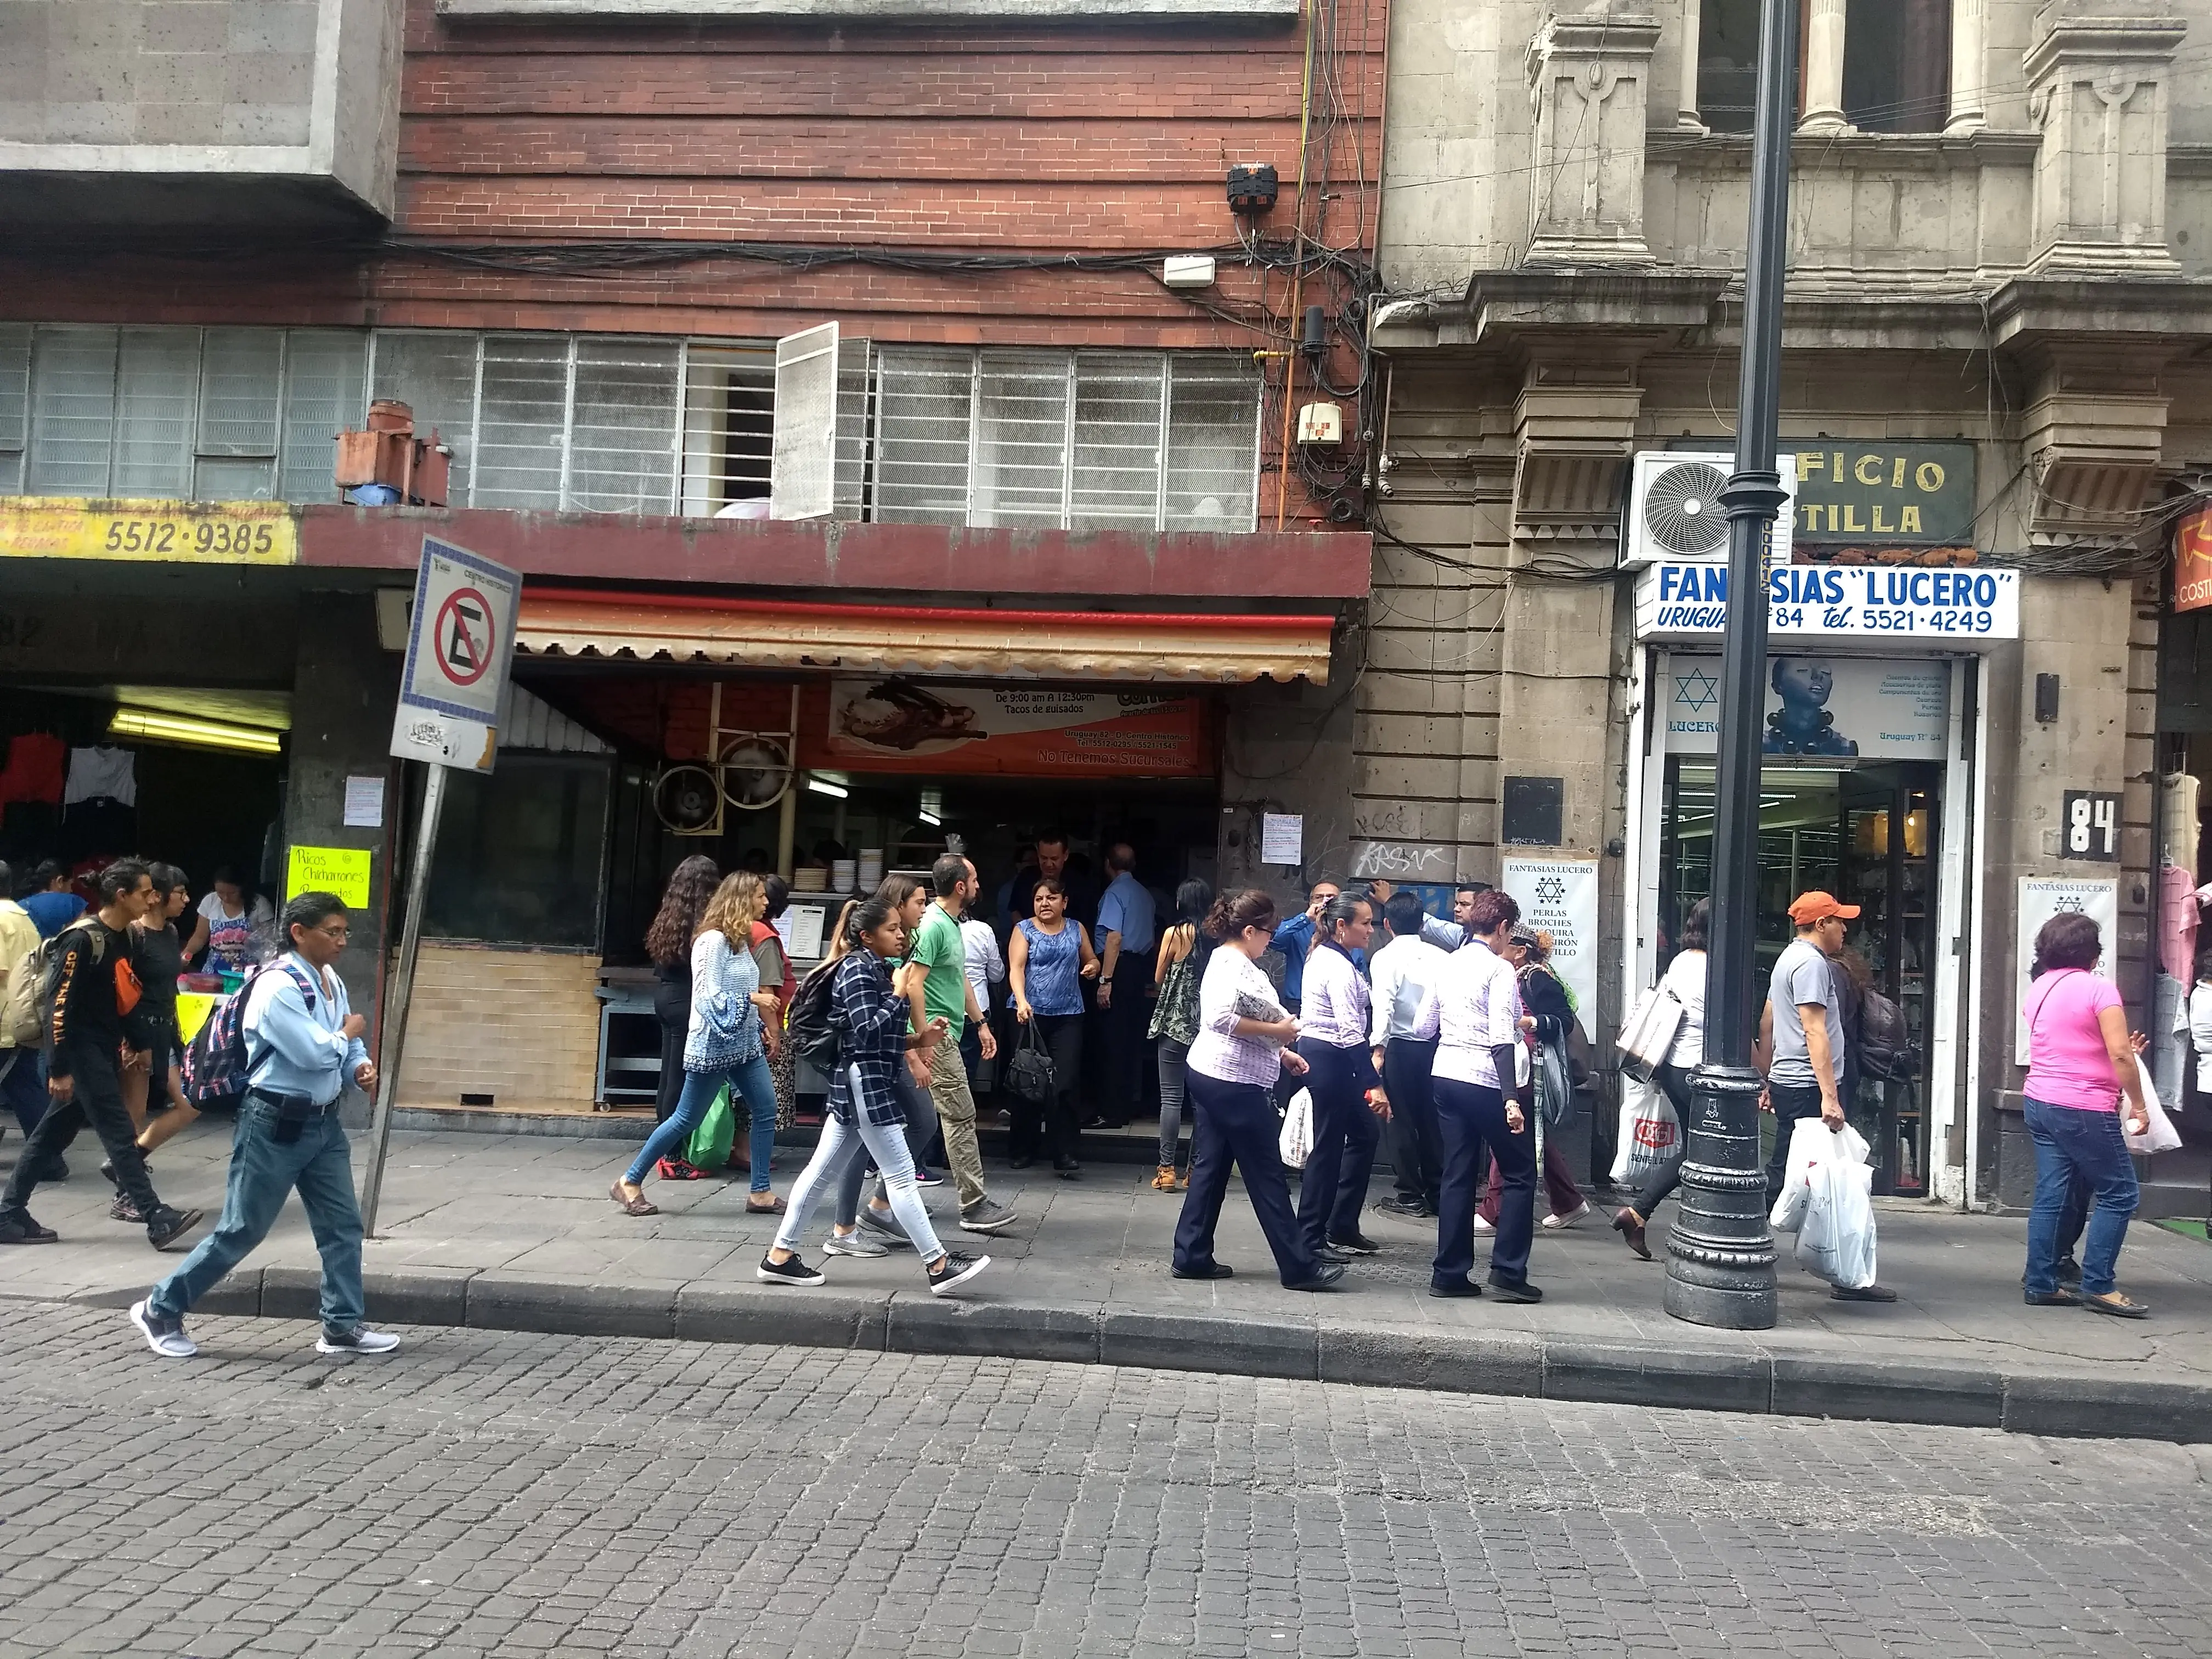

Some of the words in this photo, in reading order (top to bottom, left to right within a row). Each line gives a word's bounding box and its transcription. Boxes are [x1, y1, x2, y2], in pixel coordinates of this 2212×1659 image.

[1796, 453, 1945, 492] FICIO
[1793, 505, 1922, 533] TILLA
[1660, 567, 1844, 604] FANSIAS
[1657, 606, 1726, 629] URUGUA
[1823, 606, 1855, 629] tel.
[996, 694, 1007, 703] De
[1010, 693, 1029, 702] 9:00
[1047, 693, 1054, 702] A
[1058, 693, 1095, 702] 12:30pm
[1005, 705, 1030, 714] Tacos
[1032, 704, 1043, 713] de
[1045, 704, 1084, 714] guisados
[1065, 730, 1098, 740] Uruguay
[1126, 732, 1152, 740] Centro
[1880, 732, 1916, 741] Uruguay
[1038, 749, 1056, 763] No
[1059, 750, 1116, 765] Tenemos
[2070, 798, 2114, 854] 84
[296, 849, 326, 866] Ricos
[303, 867, 364, 883] Chicharrones
[1509, 865, 1555, 873] FANTASIAS
[2027, 883, 2074, 891] FANTASIAS
[1528, 918, 1572, 927] BROCHES
